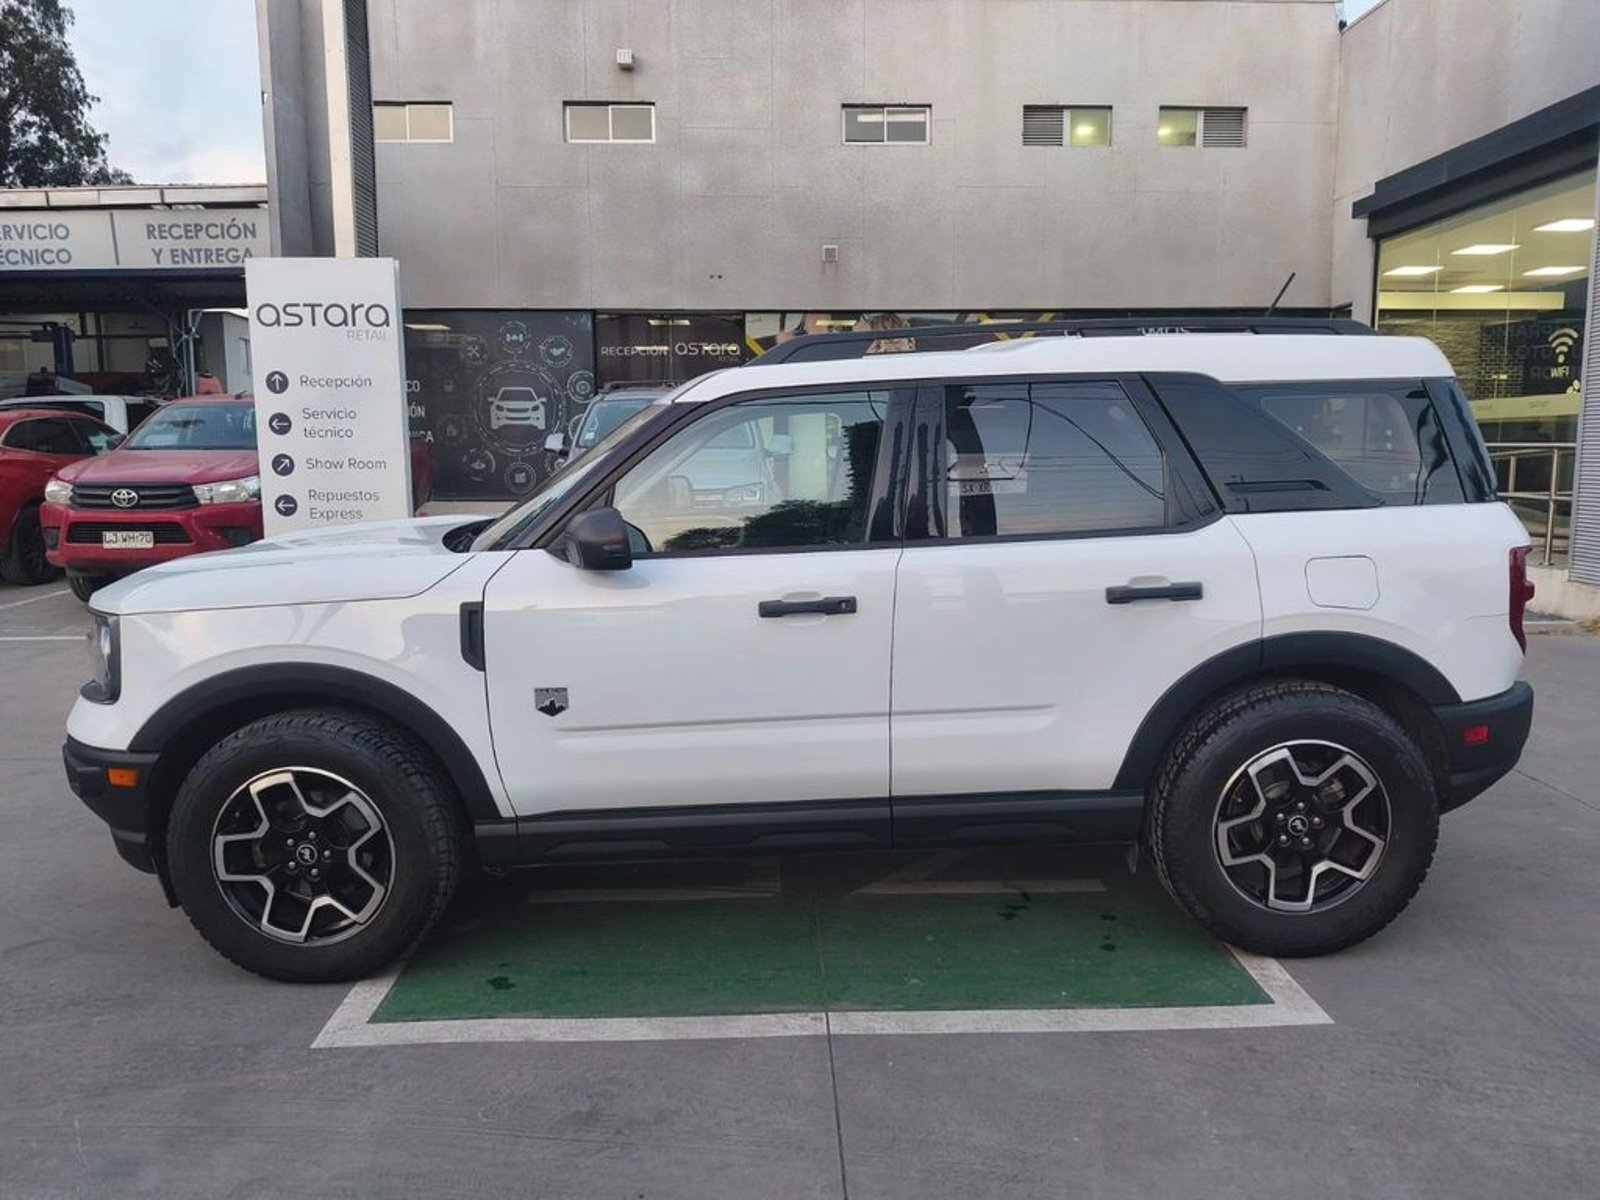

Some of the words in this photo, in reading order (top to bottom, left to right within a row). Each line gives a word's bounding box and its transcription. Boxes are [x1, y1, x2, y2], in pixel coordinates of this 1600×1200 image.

[0, 223, 70, 240] RVICIO
[145, 218, 257, 240] RECEPCIÓN
[151, 248, 163, 264] Y
[256, 303, 390, 327] astara
[300, 374, 372, 389] Recepción
[302, 407, 357, 420] Servicio
[304, 426, 354, 438] técnico
[306, 458, 344, 470] Show
[348, 458, 387, 470] Room
[308, 489, 380, 503] Repuestos
[309, 507, 363, 521] Express
